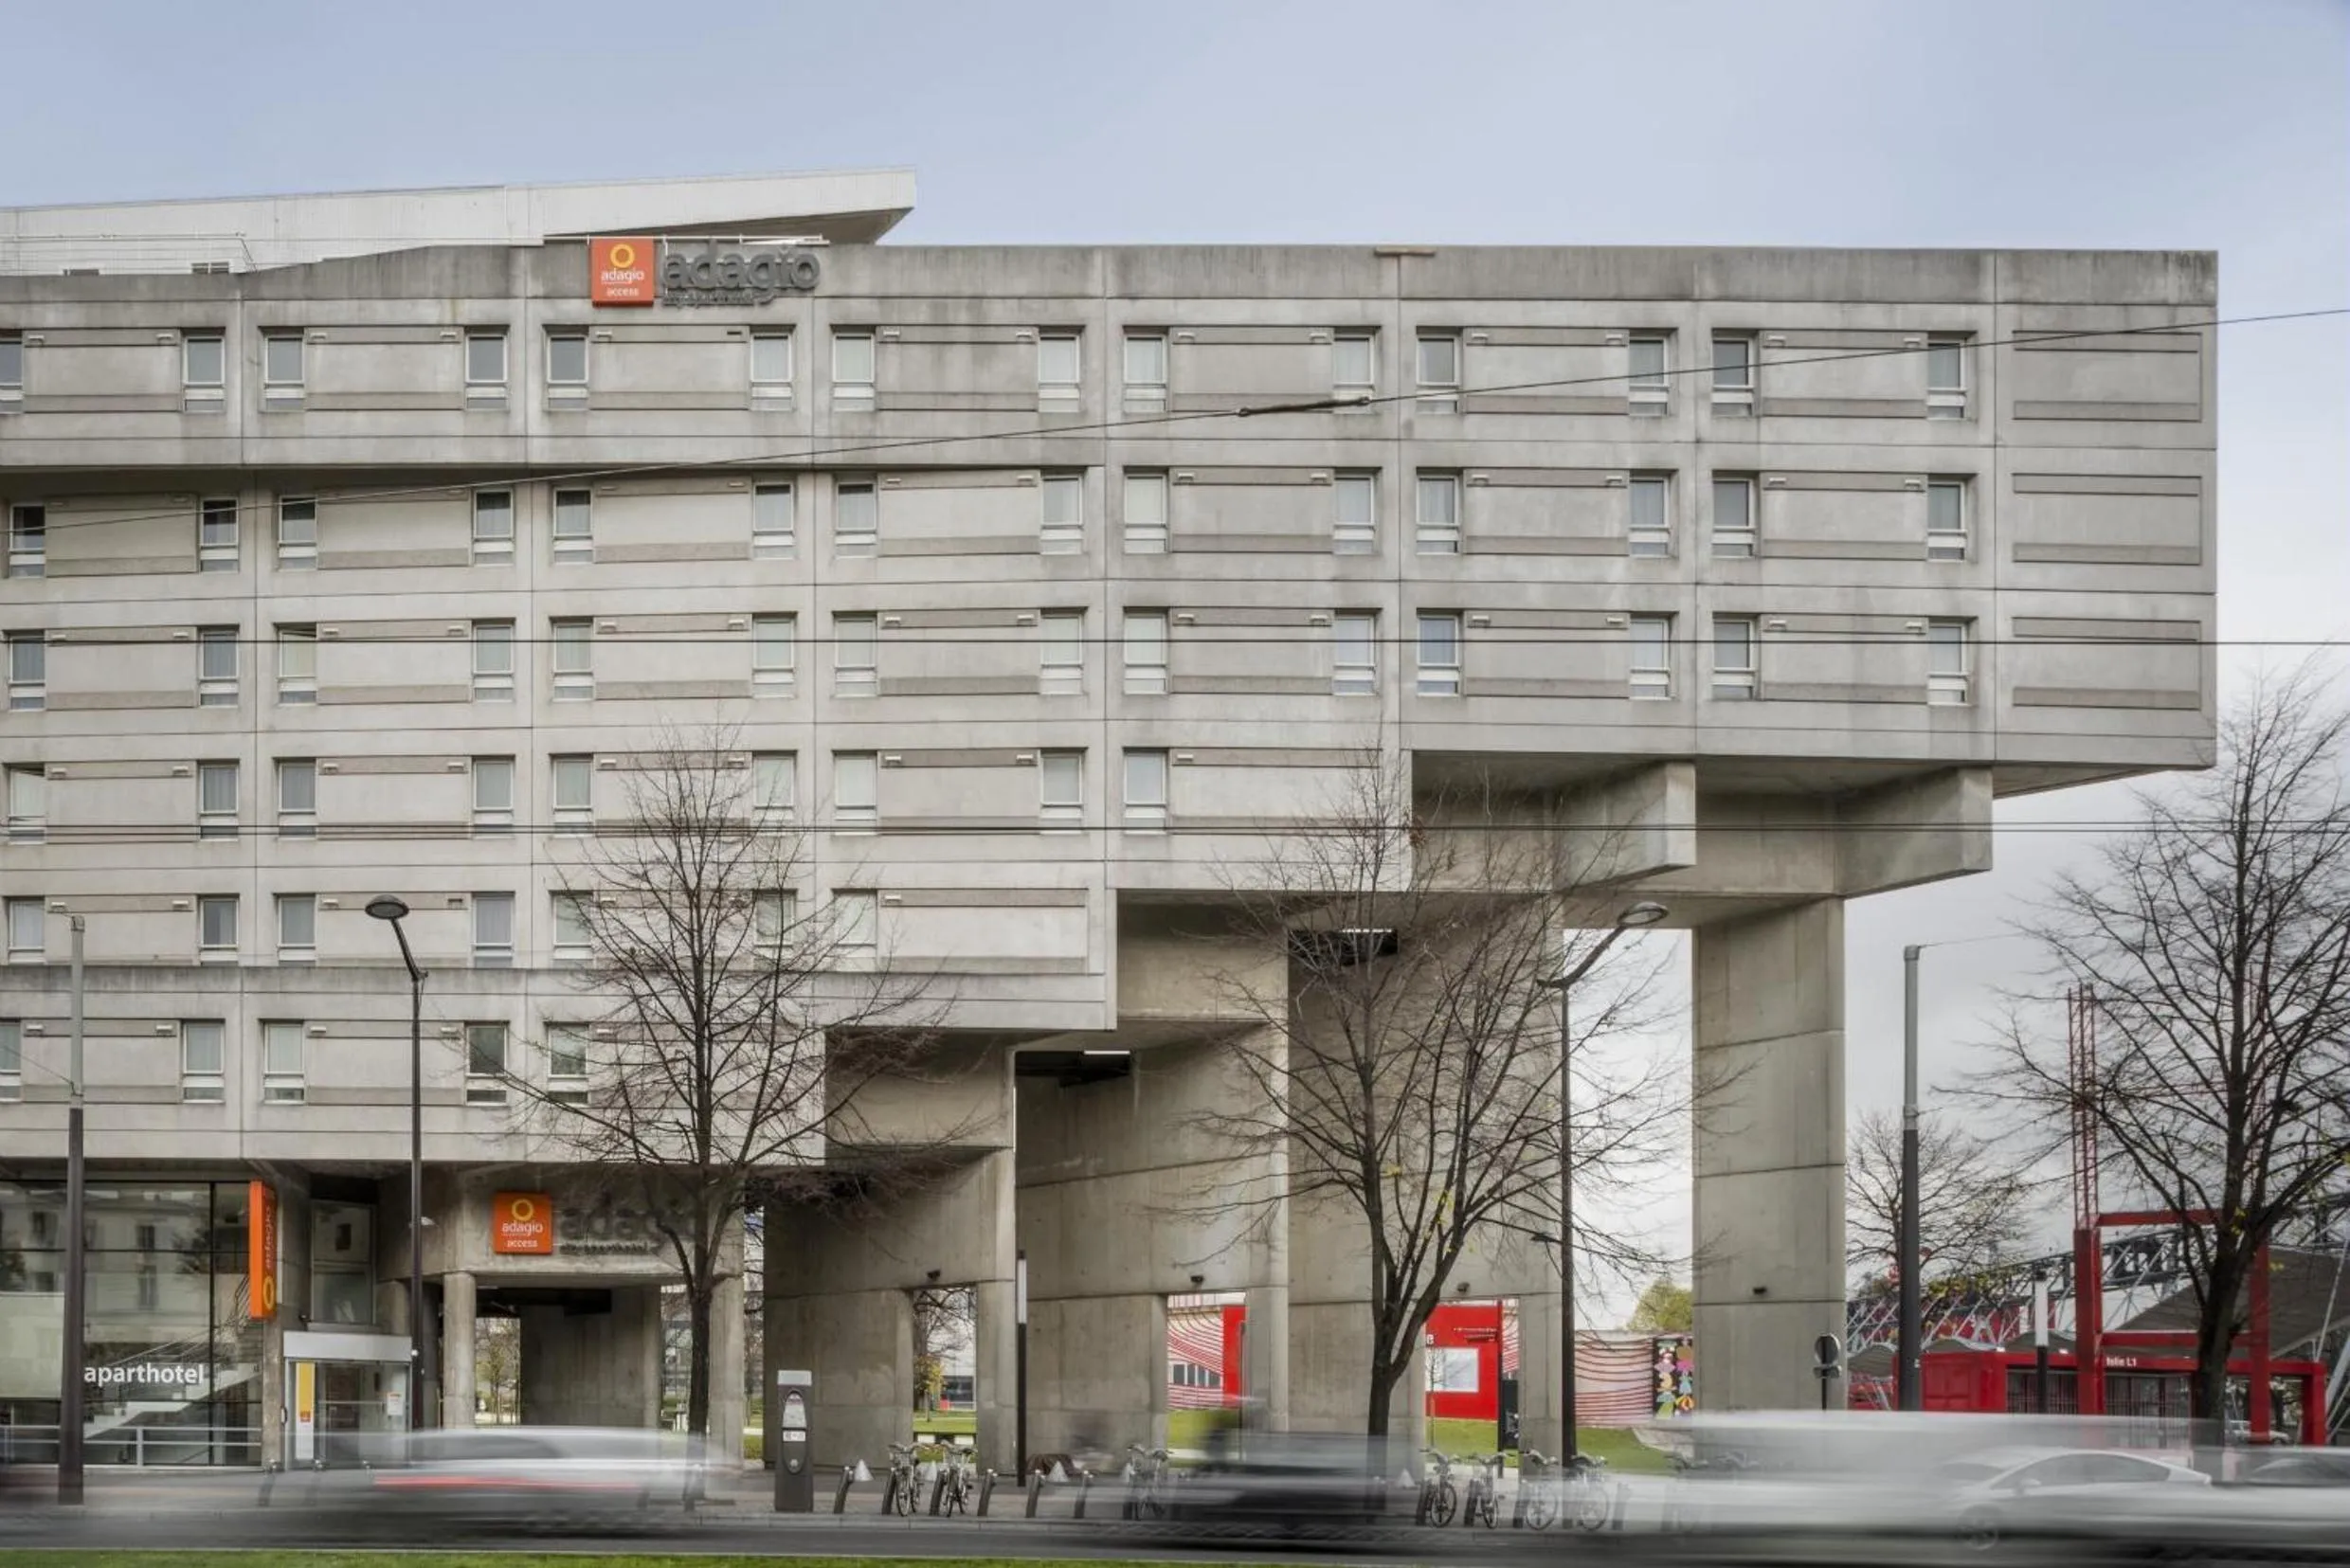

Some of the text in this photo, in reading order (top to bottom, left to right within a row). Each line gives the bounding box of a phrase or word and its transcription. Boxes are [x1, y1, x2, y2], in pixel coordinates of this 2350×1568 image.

[601, 266, 645, 284] adagio
[663, 238, 822, 306] adagio
[606, 287, 640, 297] access
[501, 1219, 544, 1236] adagio
[506, 1239, 538, 1249] access
[83, 1362, 204, 1388] aparthotel
